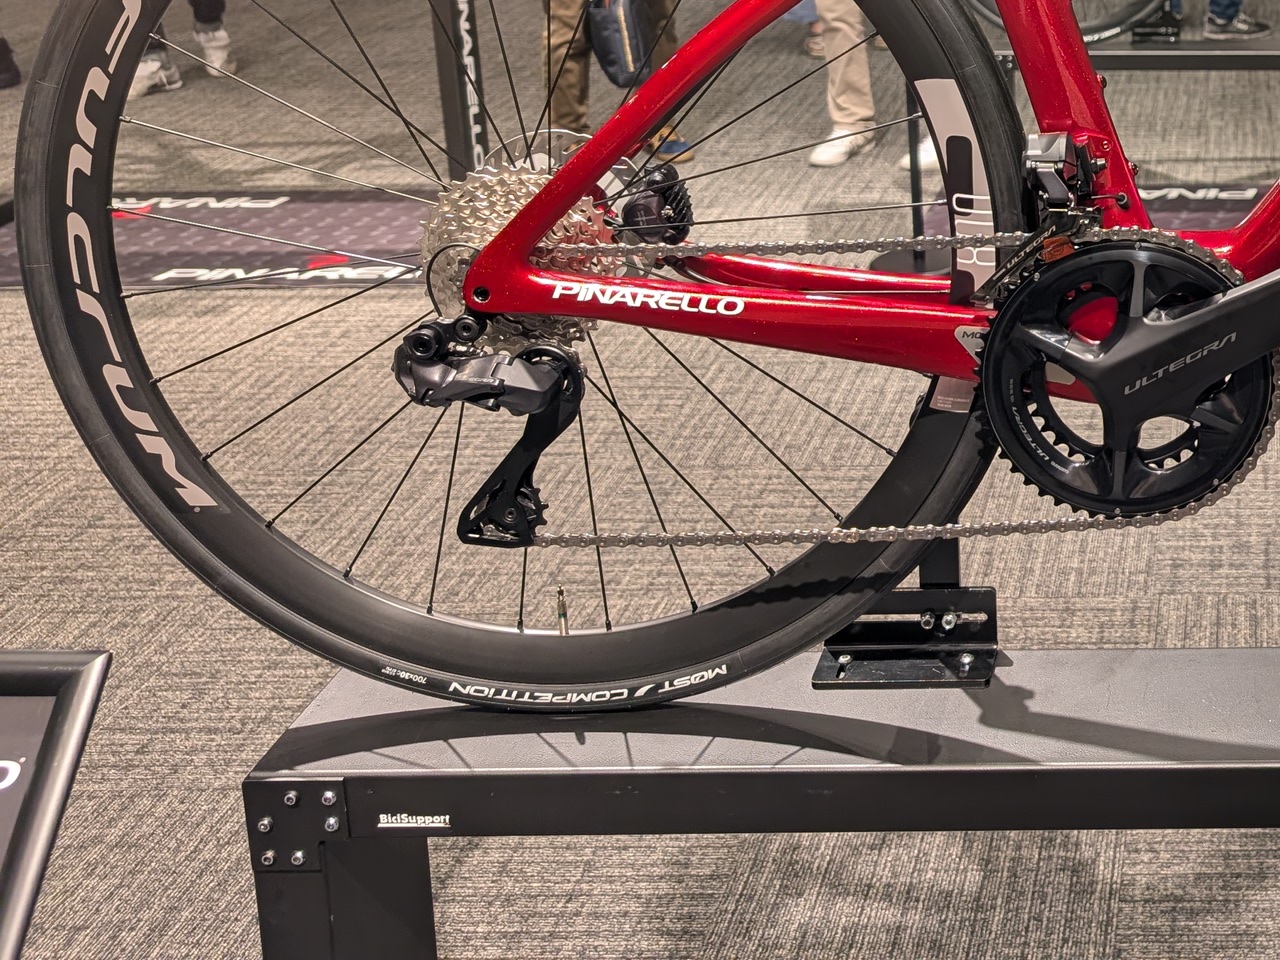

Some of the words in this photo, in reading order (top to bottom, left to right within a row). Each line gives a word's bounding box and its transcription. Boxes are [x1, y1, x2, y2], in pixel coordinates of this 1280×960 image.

[552, 283, 746, 316] PINARELLO
[1124, 331, 1237, 395] ULTEGRA
[447, 681, 629, 704] COMPETITION
[379, 813, 451, 826] BiciSupport
